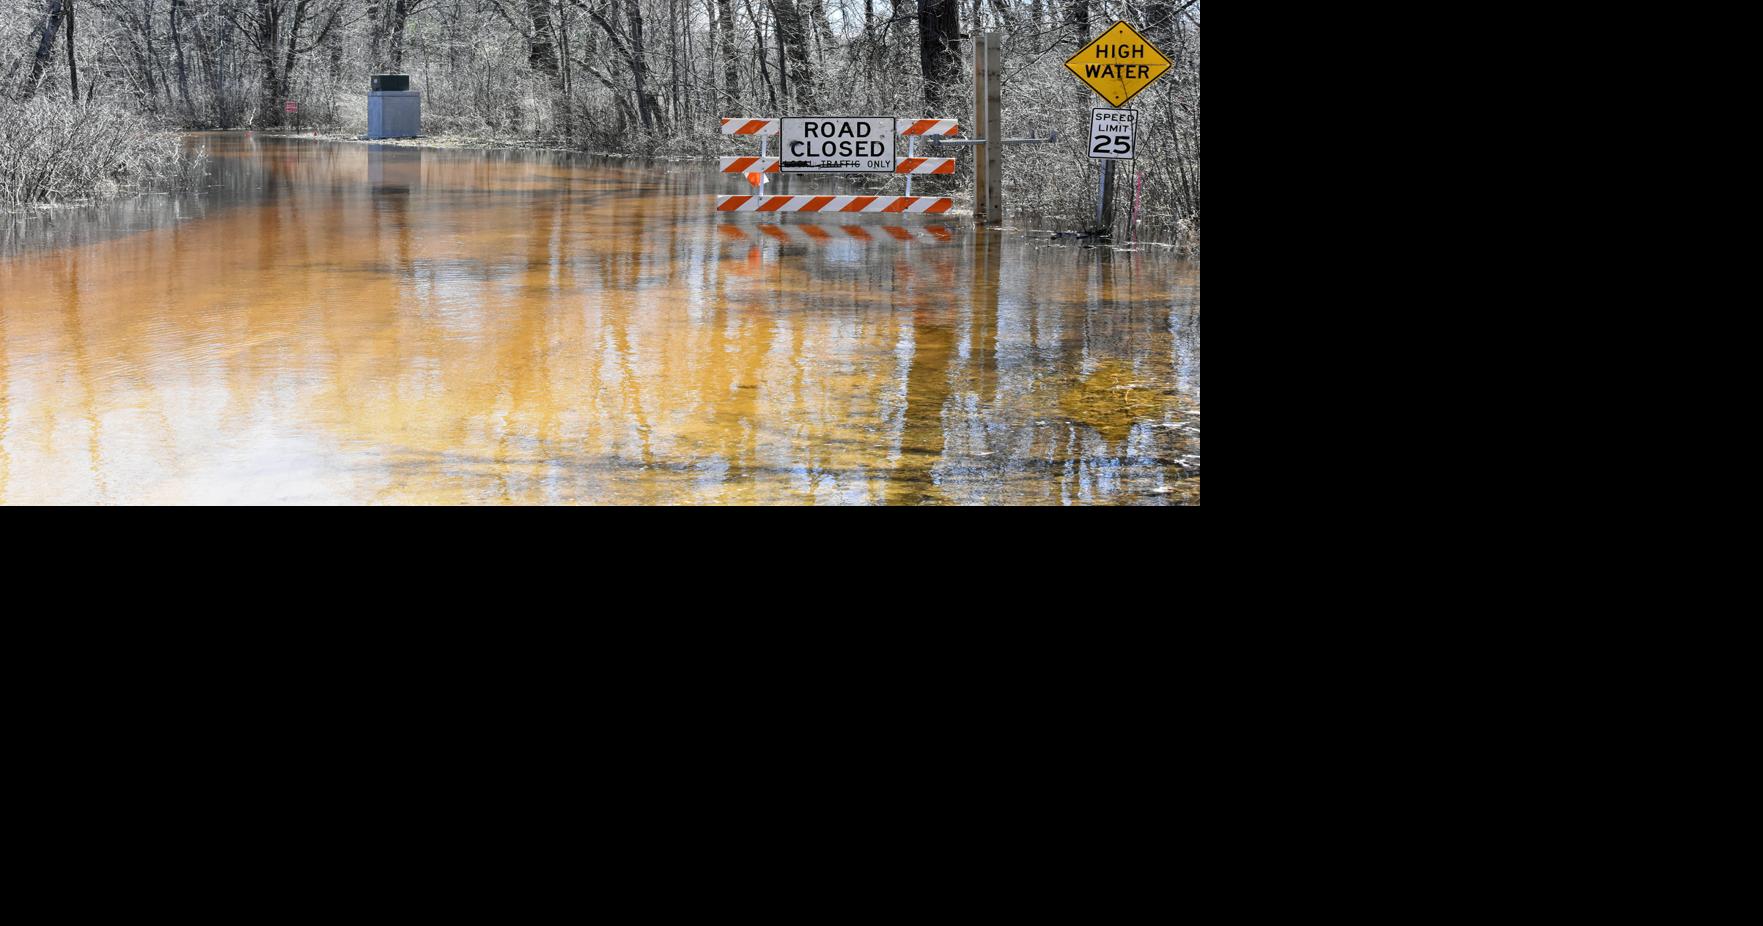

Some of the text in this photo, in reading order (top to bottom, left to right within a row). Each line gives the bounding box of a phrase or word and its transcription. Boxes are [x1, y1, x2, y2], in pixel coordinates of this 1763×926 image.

[1096, 44, 1144, 58] HIGH
[1085, 64, 1150, 79] WATER
[1095, 113, 1135, 122] SPEED
[804, 121, 871, 138] ROAD
[1098, 124, 1130, 132] LIMIT
[790, 141, 885, 157] CLOSED
[1093, 135, 1131, 154] 25
[821, 160, 861, 169] TRAFFIC
[867, 160, 891, 168] ONLY
